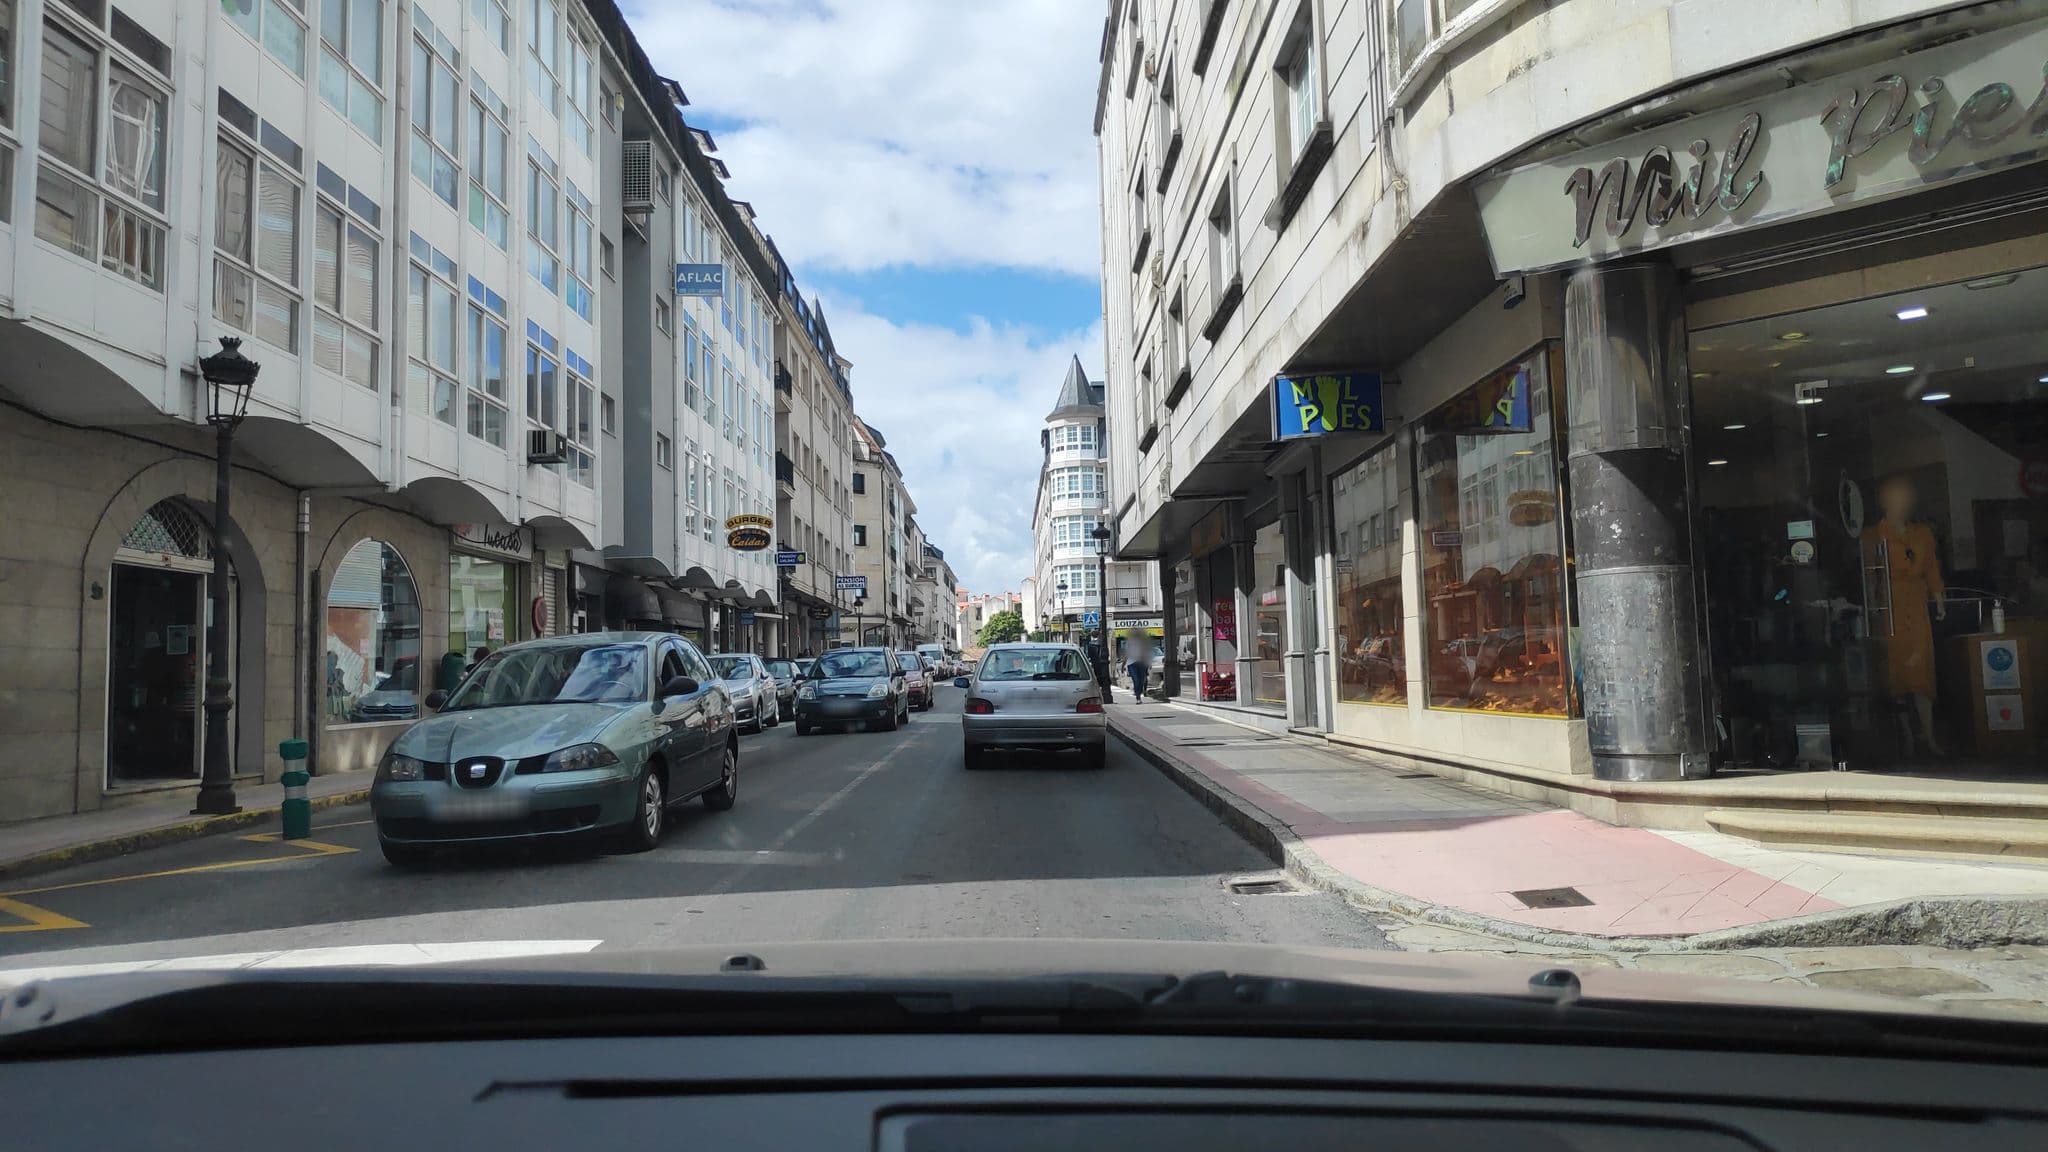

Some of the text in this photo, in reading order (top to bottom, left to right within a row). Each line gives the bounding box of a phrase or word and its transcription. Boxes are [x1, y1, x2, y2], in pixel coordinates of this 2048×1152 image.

[677, 272, 722, 283] AFLAC
[727, 516, 773, 529] BURGER
[731, 536, 767, 547] Caldas
[1115, 620, 1150, 628] LOUZAO
